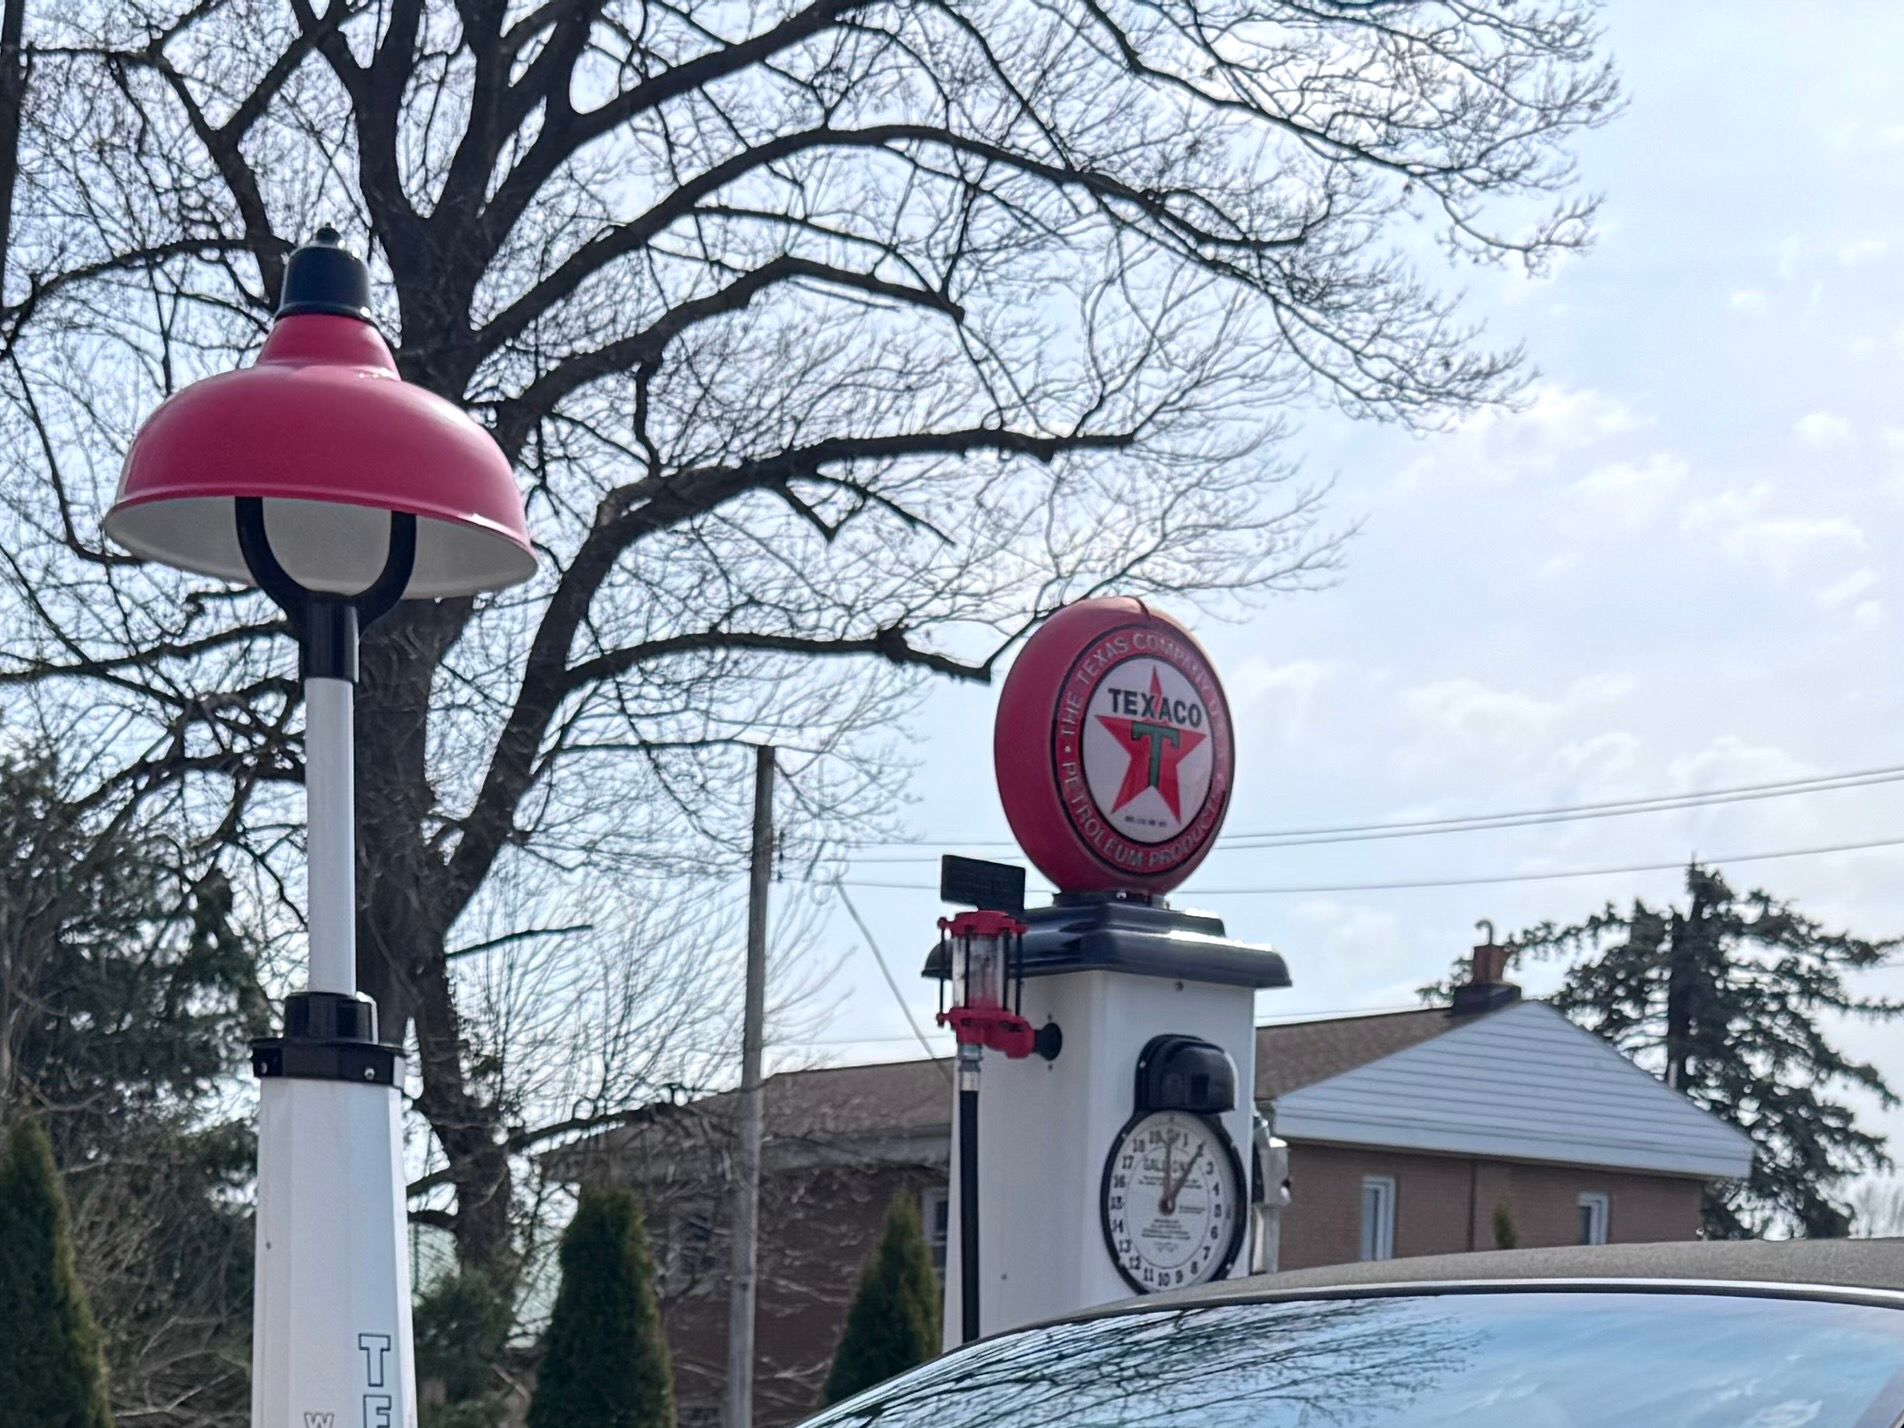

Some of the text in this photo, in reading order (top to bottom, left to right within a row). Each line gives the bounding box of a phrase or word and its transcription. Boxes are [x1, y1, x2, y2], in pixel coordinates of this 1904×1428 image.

[1077, 637, 1128, 685] TEXAS
[1108, 687, 1202, 729] TEXACO
[1131, 720, 1181, 788] T
[1062, 762, 1143, 867] PETROLEUM
[1122, 1155, 1134, 1169] 17
[1206, 1161, 1214, 1175] 3
[1213, 1183, 1220, 1196] 4
[1112, 1218, 1124, 1233] 14
[1210, 1225, 1218, 1239] 6
[1120, 1239, 1131, 1253] 13
[1203, 1246, 1211, 1261] 7
[1130, 1256, 1141, 1270] 12
[1144, 1268, 1154, 1282] 11
[1158, 1272, 1170, 1287] 10
[1176, 1269, 1184, 1283] 9
